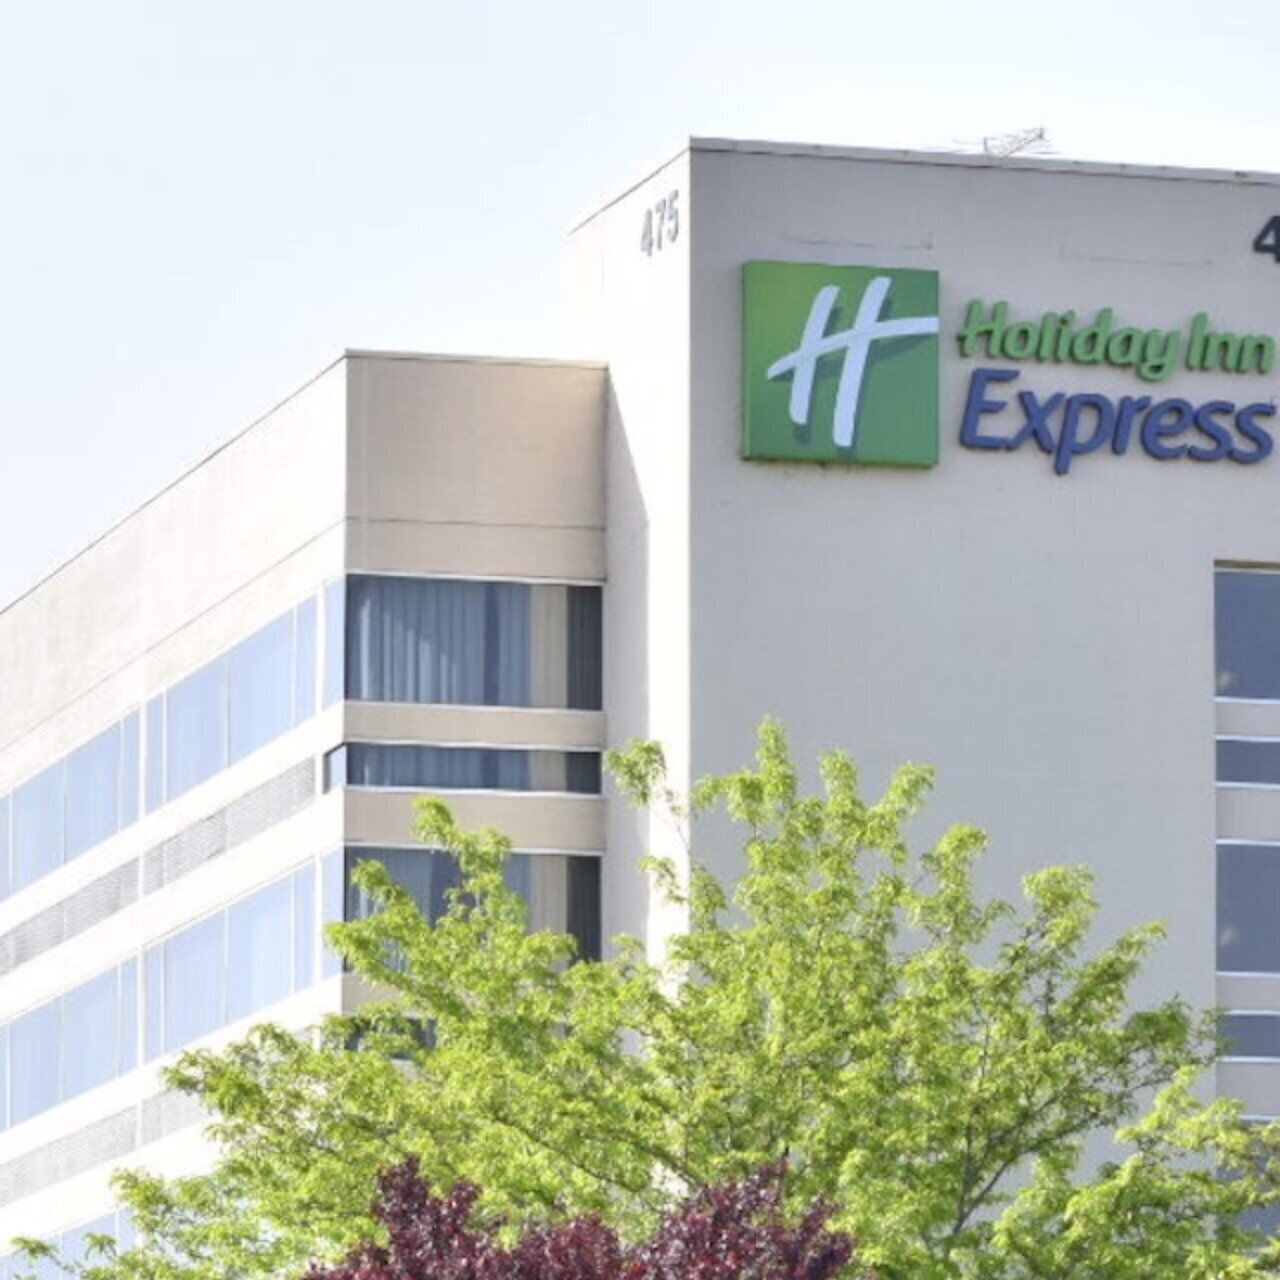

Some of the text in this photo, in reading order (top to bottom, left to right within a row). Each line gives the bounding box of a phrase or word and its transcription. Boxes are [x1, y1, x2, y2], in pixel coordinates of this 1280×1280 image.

[640, 189, 679, 257] 475
[956, 299, 1276, 381] Holiday Inn
[958, 367, 1277, 476] Express
